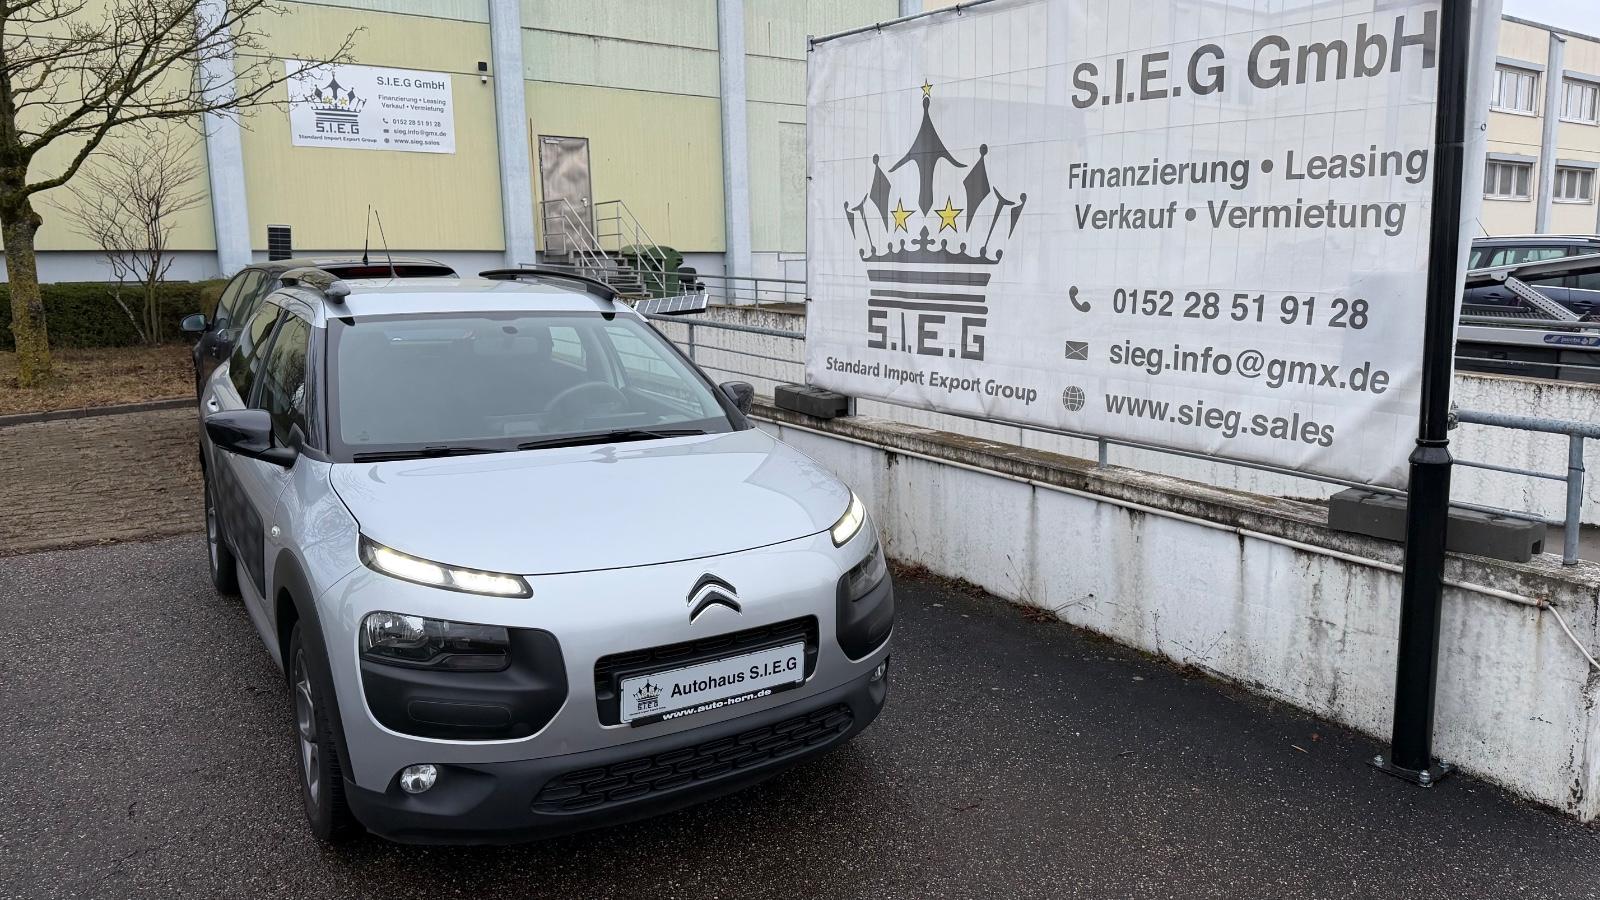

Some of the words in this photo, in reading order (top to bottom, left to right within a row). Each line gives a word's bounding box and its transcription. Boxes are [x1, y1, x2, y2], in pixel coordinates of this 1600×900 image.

[1072, 44, 1225, 109] S.I.E.G
[1248, 10, 1438, 90] GmbH
[376, 76, 411, 88] S.I.E.G
[414, 79, 446, 90] GmbH
[378, 94, 418, 103] Finanzierung
[422, 98, 447, 106] Leasing
[315, 122, 360, 134] S.I.E.G
[381, 102, 405, 110] Verkauf
[410, 105, 445, 114] Vermietung
[392, 118, 408, 126] 0152
[1068, 158, 1250, 191] Finanzierung
[1286, 145, 1429, 185] Leasing
[1075, 201, 1178, 230] Verkauf
[1208, 198, 1407, 237] Vermietung
[1112, 288, 1174, 318] 0152
[1183, 291, 1219, 320] 28
[1231, 292, 1265, 323] 51
[1280, 293, 1315, 326] 91
[1329, 296, 1368, 329] 28
[867, 309, 987, 361] S.I.E.G
[826, 356, 880, 378] Standard
[884, 364, 925, 386] Import
[929, 371, 982, 394] Export
[985, 379, 1038, 405] Group
[1109, 340, 1390, 395] sieg.info@gmx.de
[1105, 394, 1335, 448] www.sieg.sales
[670, 671, 745, 698] Autohaus
[749, 656, 797, 680] S.I.E.G
[662, 689, 772, 721] www.auto-horn.de
